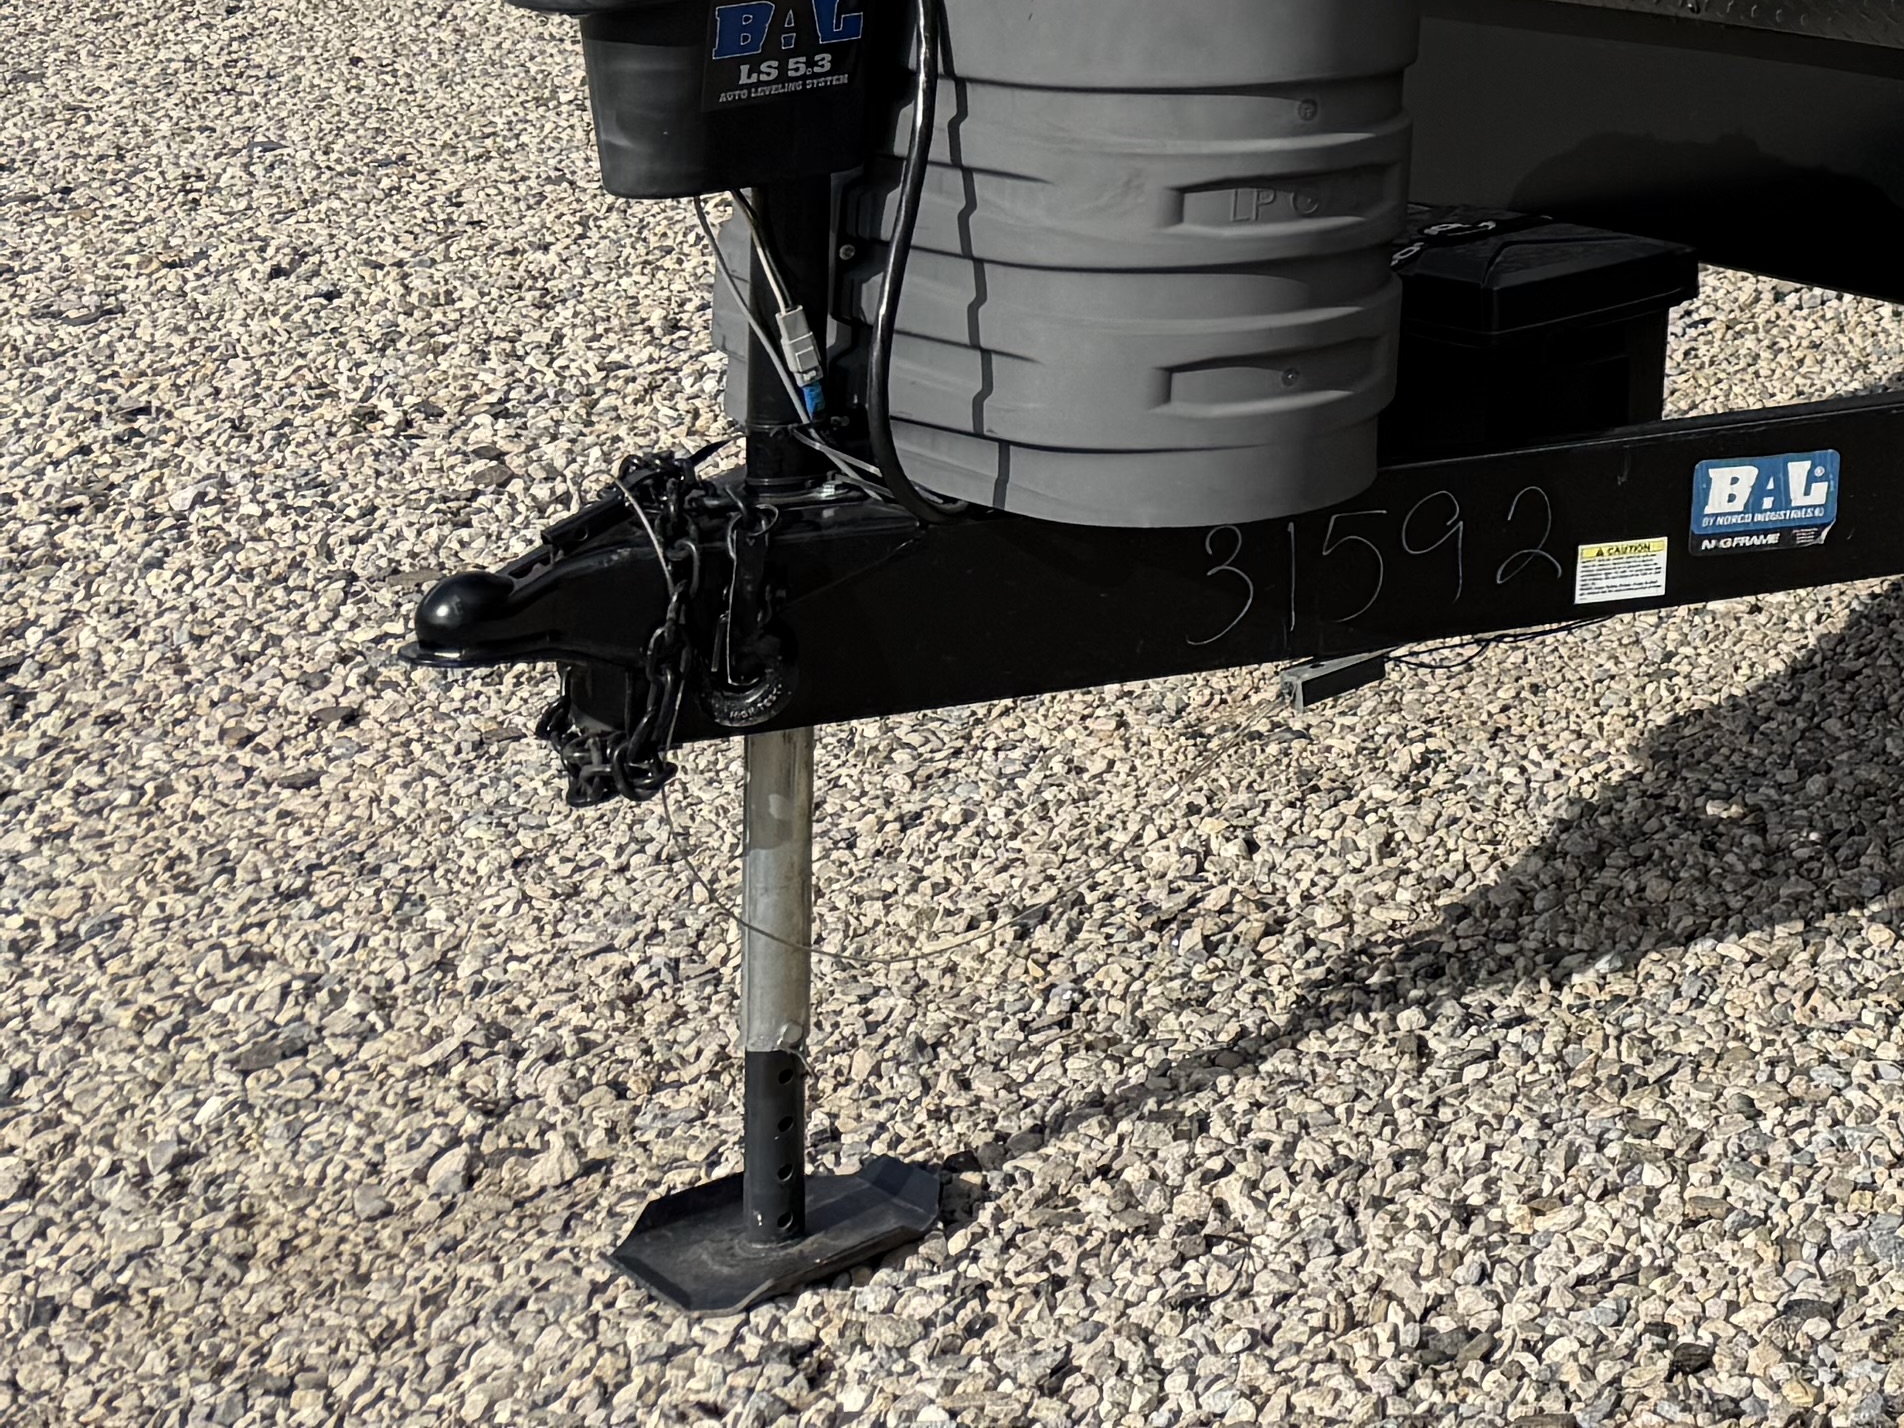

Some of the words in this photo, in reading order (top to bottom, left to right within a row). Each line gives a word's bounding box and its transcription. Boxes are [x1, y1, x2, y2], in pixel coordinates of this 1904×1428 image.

[738, 60, 780, 85] LS
[787, 52, 832, 77] 5.3
[718, 89, 749, 103] AUTO
[751, 80, 803, 98] LEVELING
[805, 74, 849, 89] SYSTEM
[1702, 515, 1716, 528] BY
[1716, 512, 1752, 527] NORCO
[1607, 543, 1651, 556] CAUTION
[1185, 486, 1562, 646] 31592
